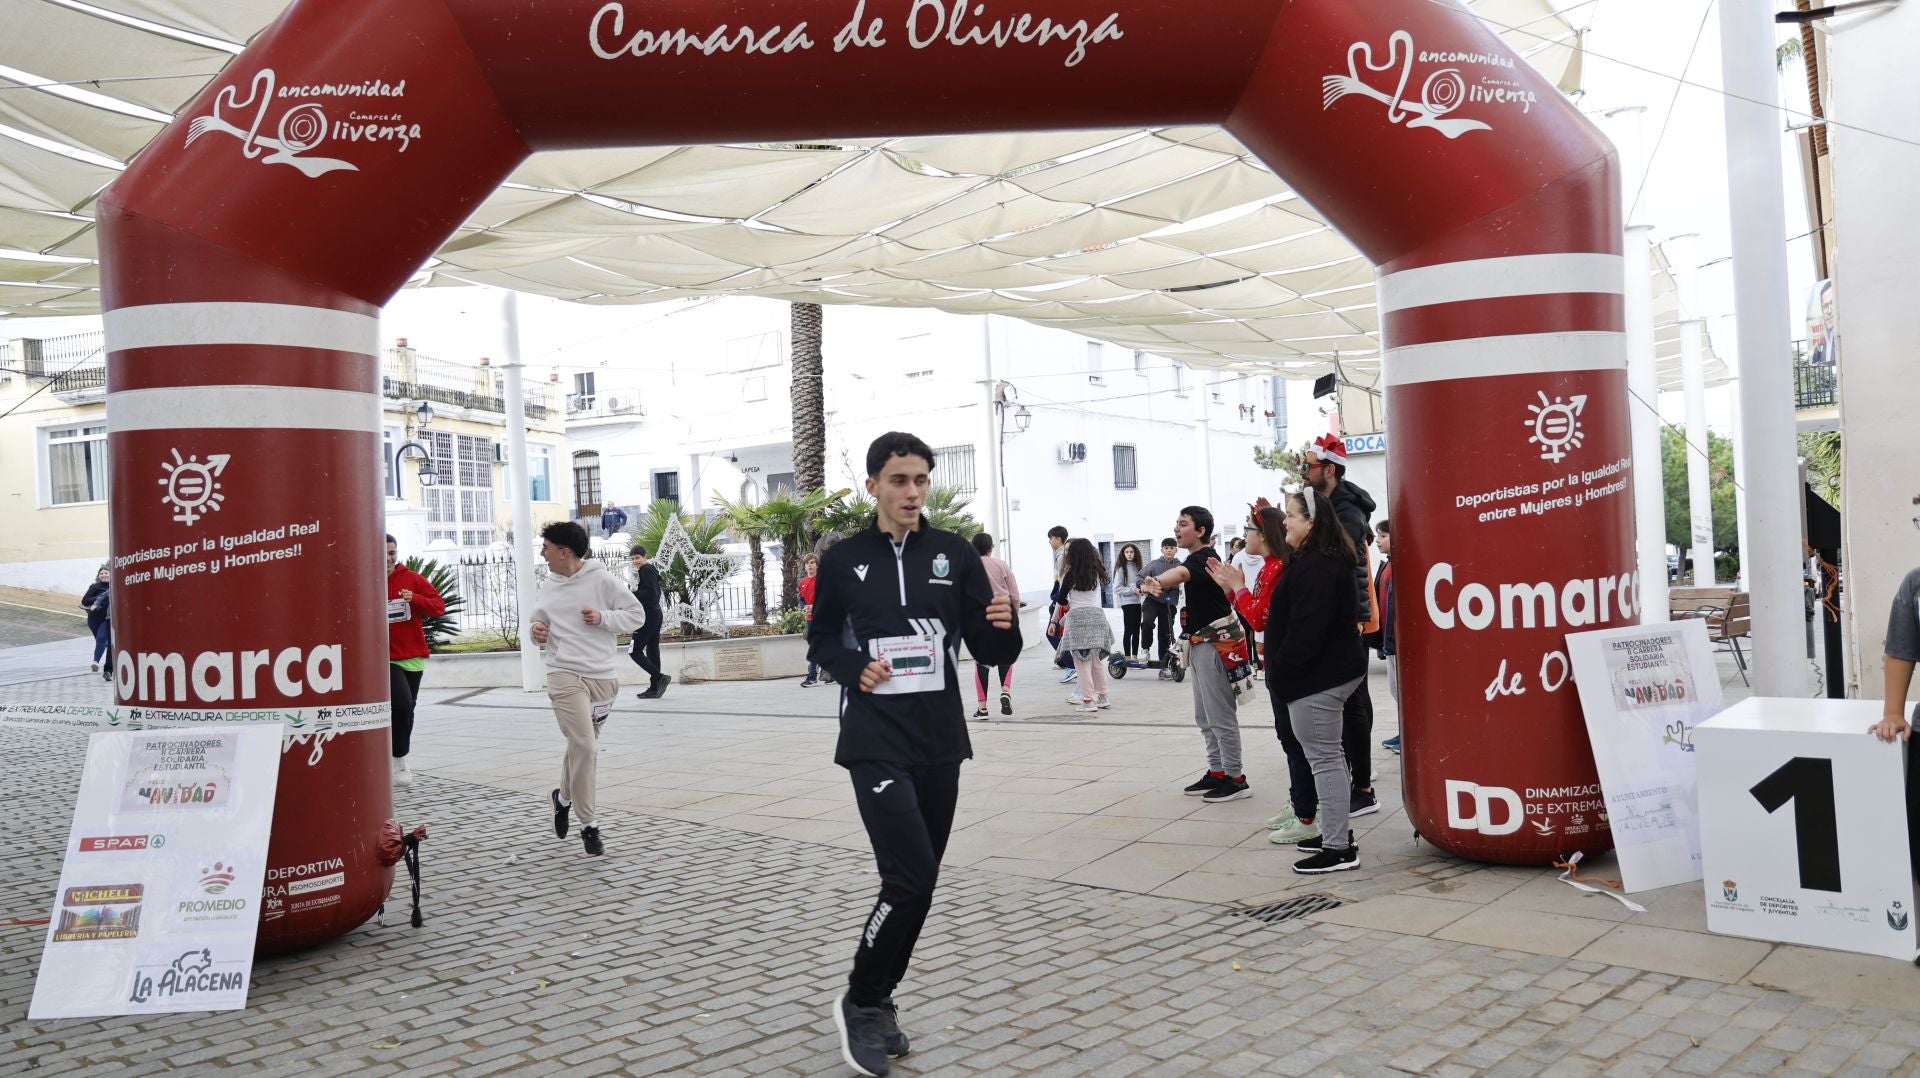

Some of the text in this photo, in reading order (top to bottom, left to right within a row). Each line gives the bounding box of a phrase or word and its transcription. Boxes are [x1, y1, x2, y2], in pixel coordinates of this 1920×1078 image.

[589, 0, 1125, 68] Comarca de Olivenza
[349, 111, 402, 121] Comarca de
[1456, 483, 1539, 508] Deportistas
[1542, 477, 1565, 494] por
[1568, 473, 1579, 486] la
[1581, 460, 1620, 485] Igualdad
[1478, 478, 1627, 522] entre Mujeres y Hombres!!
[114, 520, 320, 569] Deportistas por la Igualdad Real
[124, 543, 302, 586] entre Mujeres y Hombres!!
[1612, 636, 1673, 649] PATROCINADORES
[1633, 645, 1663, 655] CARRERA
[1629, 653, 1665, 663] SOLIDARIA
[1626, 660, 1668, 671] ESTUDIANTIL
[116, 643, 343, 703] omarca
[1484, 658, 1526, 702] de
[8, 705, 104, 717] EXTREMADURA DEPORTE
[145, 710, 281, 722] EXTREMADURA DEPORTE
[145, 740, 222, 750] PATROCINADORES
[168, 747, 206, 756] CARRERA
[160, 755, 205, 764] SOLIDARIA
[153, 763, 207, 771] ESTUDIANTIL
[1525, 783, 1600, 799] DINAMIZACI
[1526, 799, 1607, 815] DE EXTREMA
[1749, 757, 1842, 893] 1
[93, 837, 147, 849] SPAR
[268, 857, 345, 880] DEPORTIVA
[290, 875, 343, 891] #SOMOSDEPORTE
[178, 898, 247, 912] PROMEDIO
[1768, 902, 1798, 910] DEPORTES
[1768, 908, 1798, 917] JUVENTUD
[158, 969, 242, 996] ALACENA
